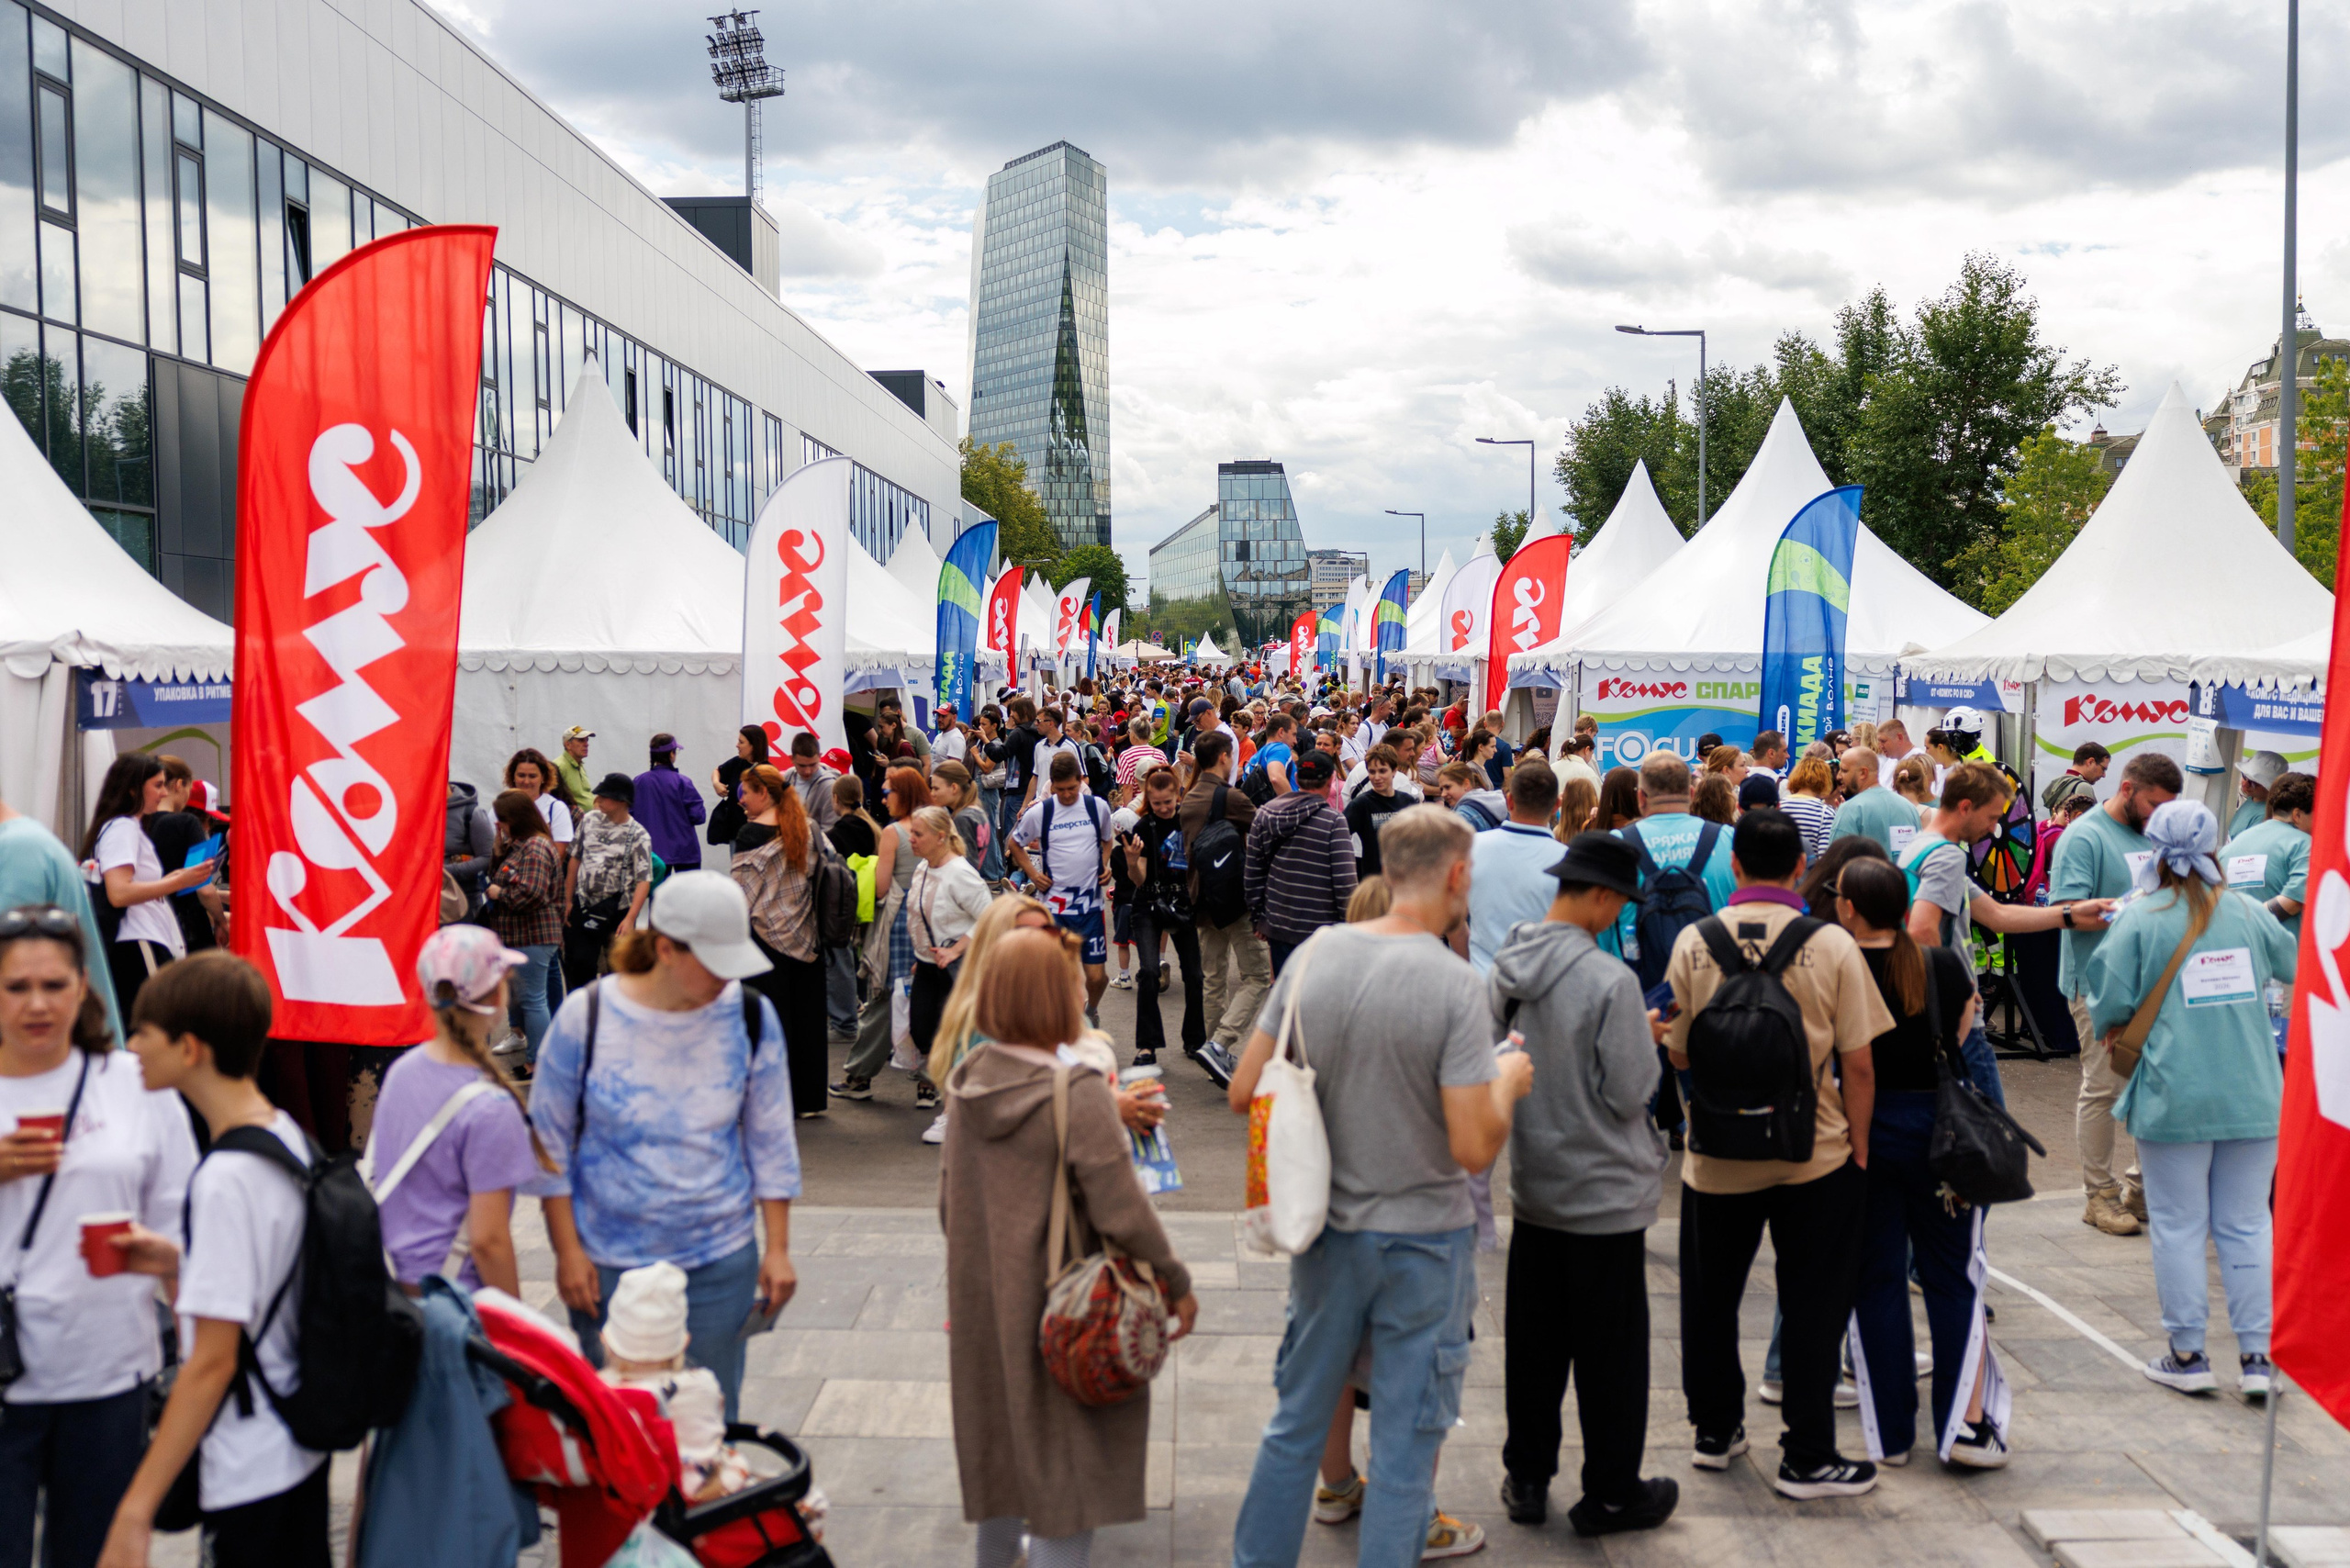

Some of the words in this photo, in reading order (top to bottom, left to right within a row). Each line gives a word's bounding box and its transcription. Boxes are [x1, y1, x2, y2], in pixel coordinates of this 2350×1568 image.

[939, 651, 956, 704] ИАДА
[1598, 677, 1687, 700] Комус
[1696, 682, 1760, 700] СПАР
[91, 681, 117, 717] 17
[153, 687, 196, 701] УПАКОВКА
[198, 685, 205, 699] В
[206, 685, 232, 700] РИТМЕ
[2199, 686, 2214, 715] 8
[264, 423, 421, 1005] Комус
[1795, 655, 1824, 762] АКИАДА
[2065, 694, 2189, 727] Комус
[2254, 704, 2271, 720] ДЛЯ
[2272, 705, 2288, 720] ВАС
[2289, 707, 2297, 721] И
[1596, 731, 1700, 767] FOCU
[1048, 817, 1096, 832] Северстал
[1643, 832, 1699, 849] АРЯЖА
[1652, 846, 1696, 864] АНИЯ
